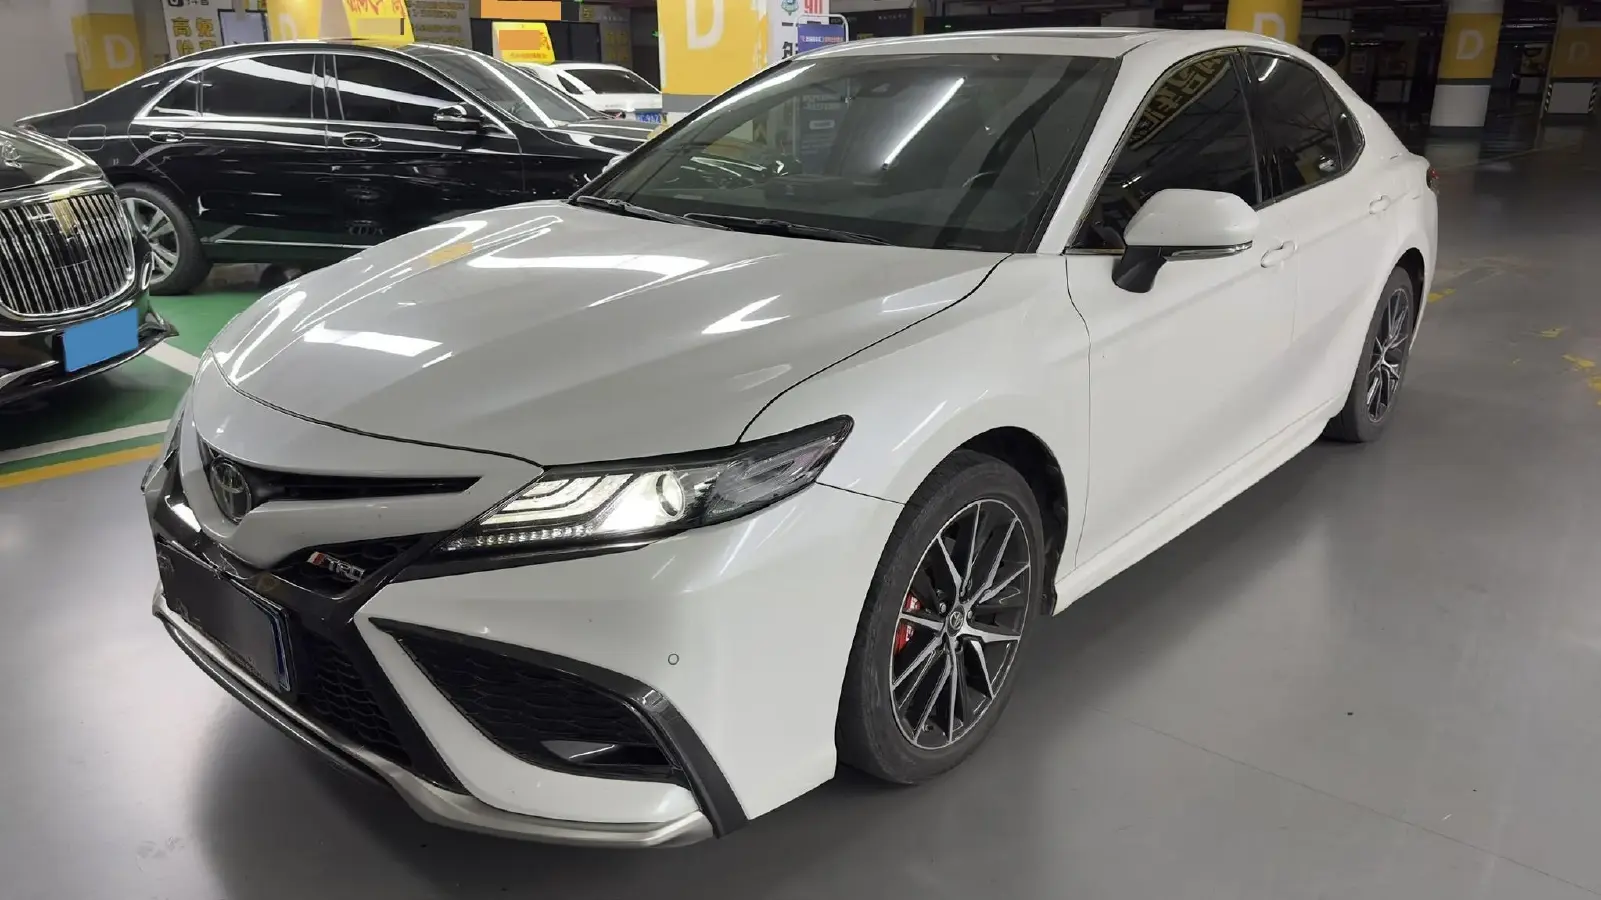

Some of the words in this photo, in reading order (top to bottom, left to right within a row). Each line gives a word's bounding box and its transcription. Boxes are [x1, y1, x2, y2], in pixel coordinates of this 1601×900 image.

[1253, 13, 1286, 39] D
[104, 34, 135, 69] D
[1457, 29, 1484, 60] D
[1569, 41, 1591, 63] D
